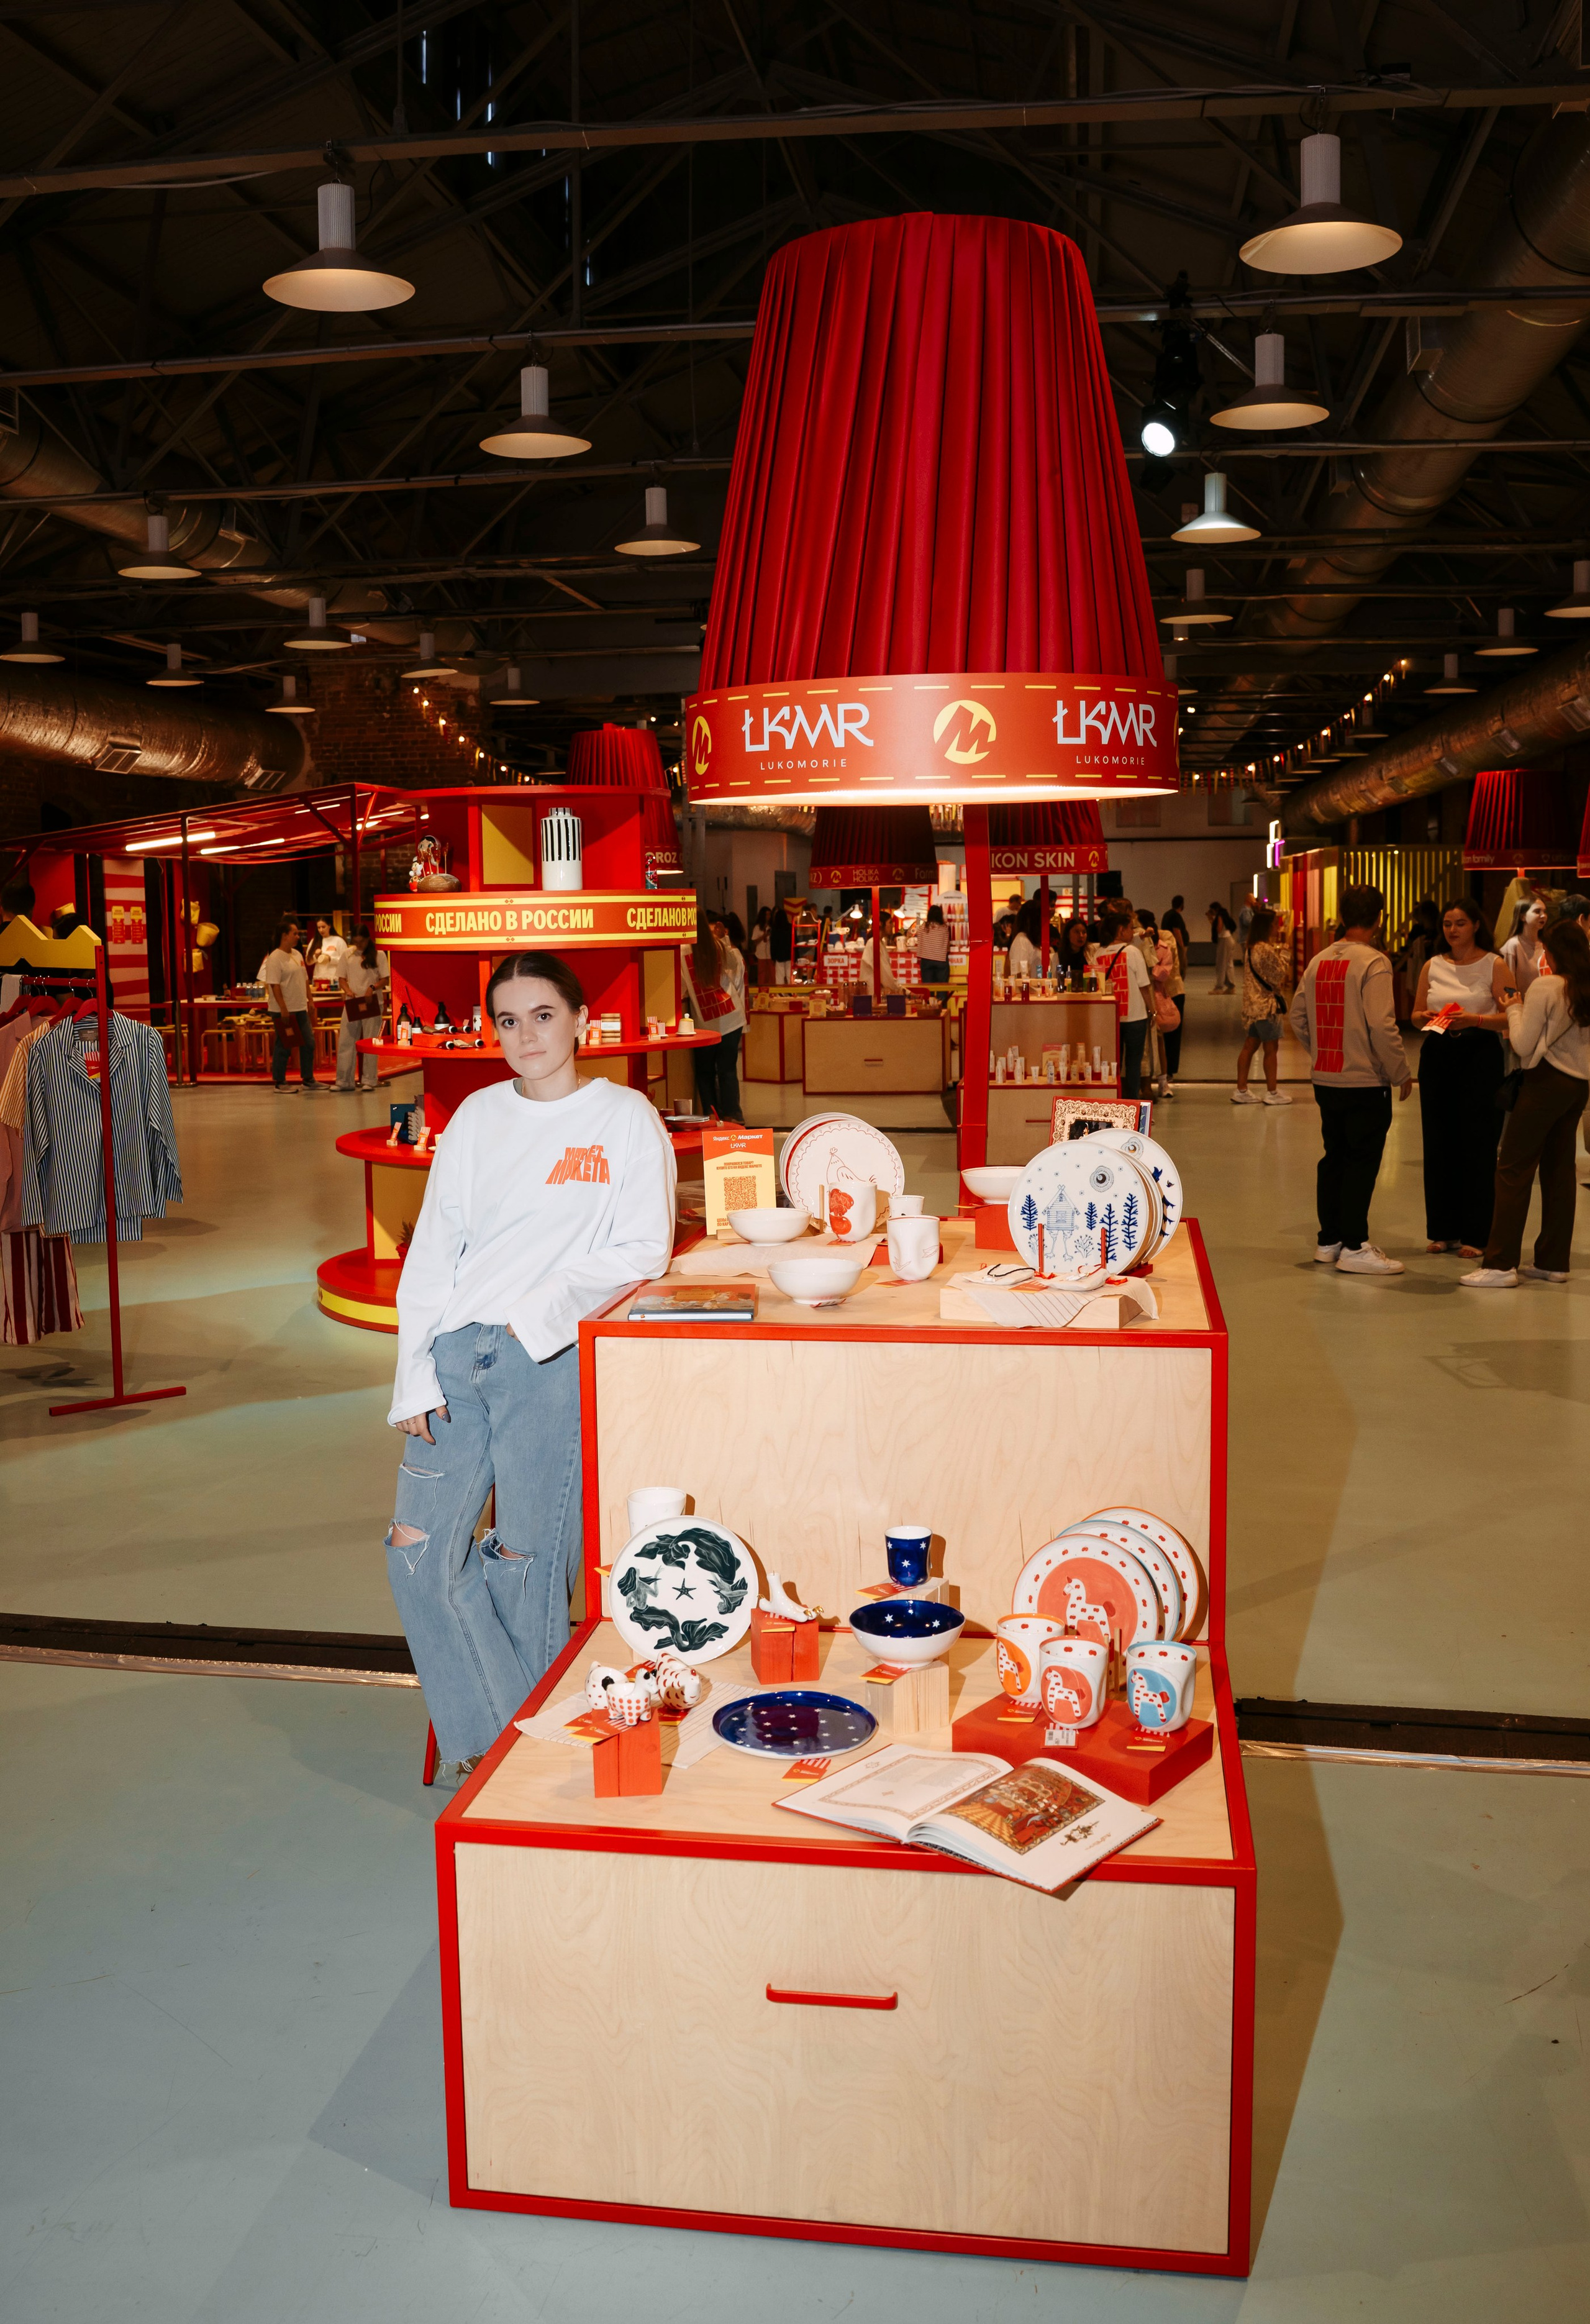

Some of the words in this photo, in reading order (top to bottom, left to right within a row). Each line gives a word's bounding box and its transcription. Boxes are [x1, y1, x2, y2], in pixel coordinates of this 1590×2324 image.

[760, 759, 847, 770] LUKOMORIE
[1076, 755, 1146, 765] LUKOMORIE
[992, 852, 1028, 868] ICON
[1034, 852, 1074, 868] SKIN
[425, 910, 504, 934] СДЕЛАНО
[506, 911, 518, 930] В
[522, 908, 594, 930] РОССИИ
[627, 908, 681, 930] СДЕЛАНО
[681, 908, 687, 926] В
